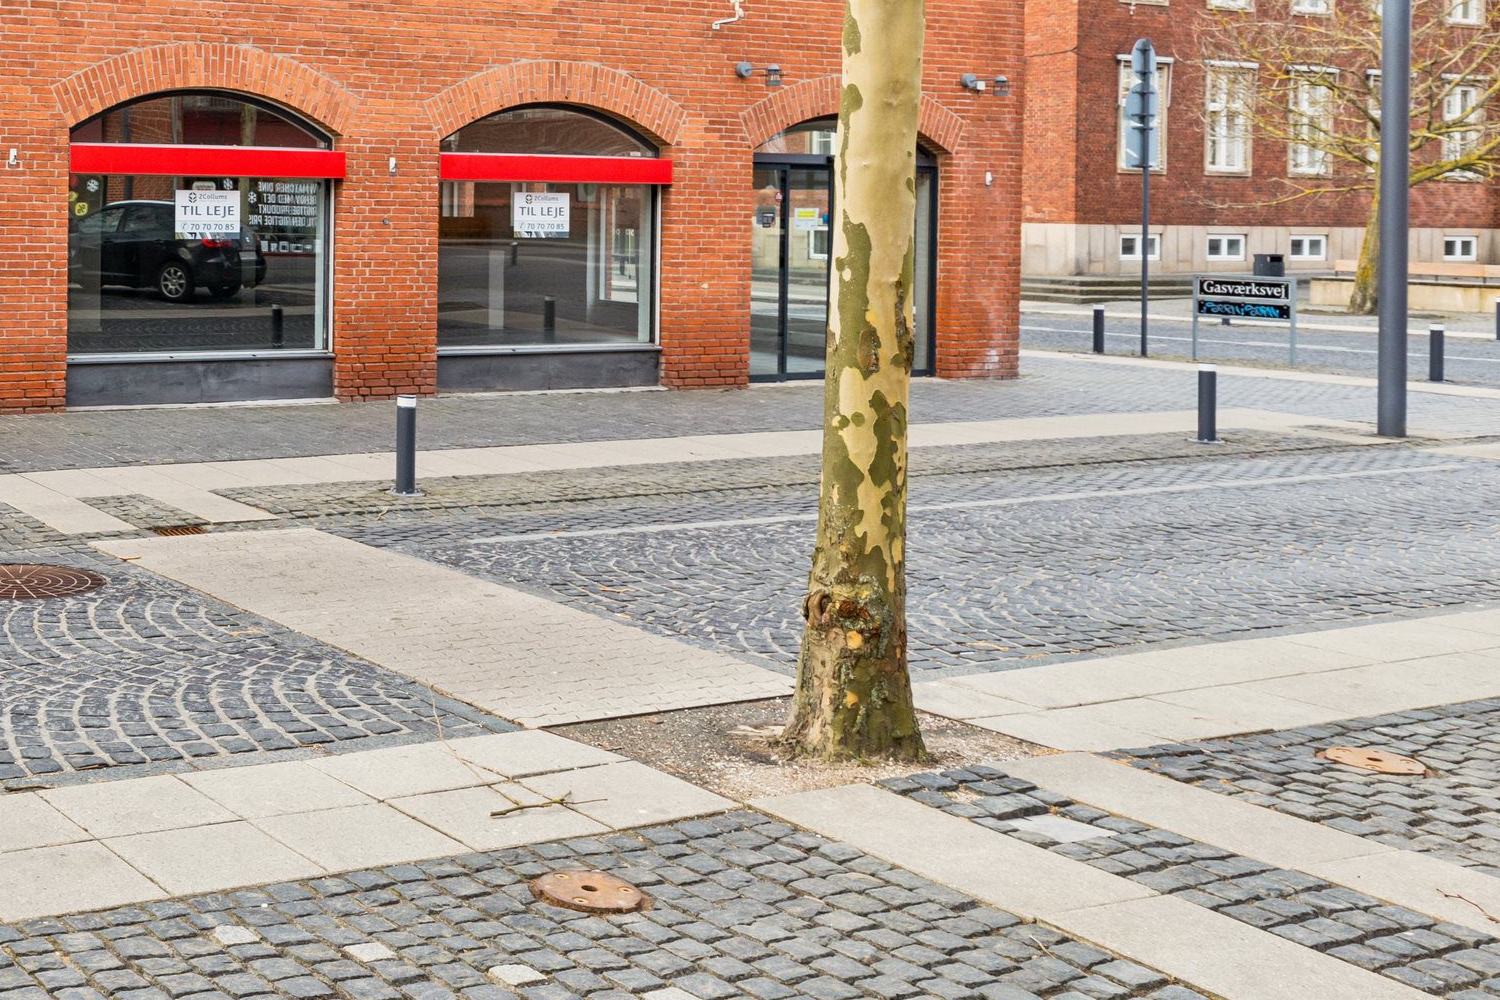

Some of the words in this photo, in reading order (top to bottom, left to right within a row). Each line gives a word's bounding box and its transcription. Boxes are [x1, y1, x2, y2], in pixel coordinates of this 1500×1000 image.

[181, 205, 202, 215] TIL
[206, 205, 235, 218] LEJE
[518, 206, 536, 216] TIL
[541, 206, 564, 218] LEJE
[1203, 280, 1286, 299] Gasværksvej
